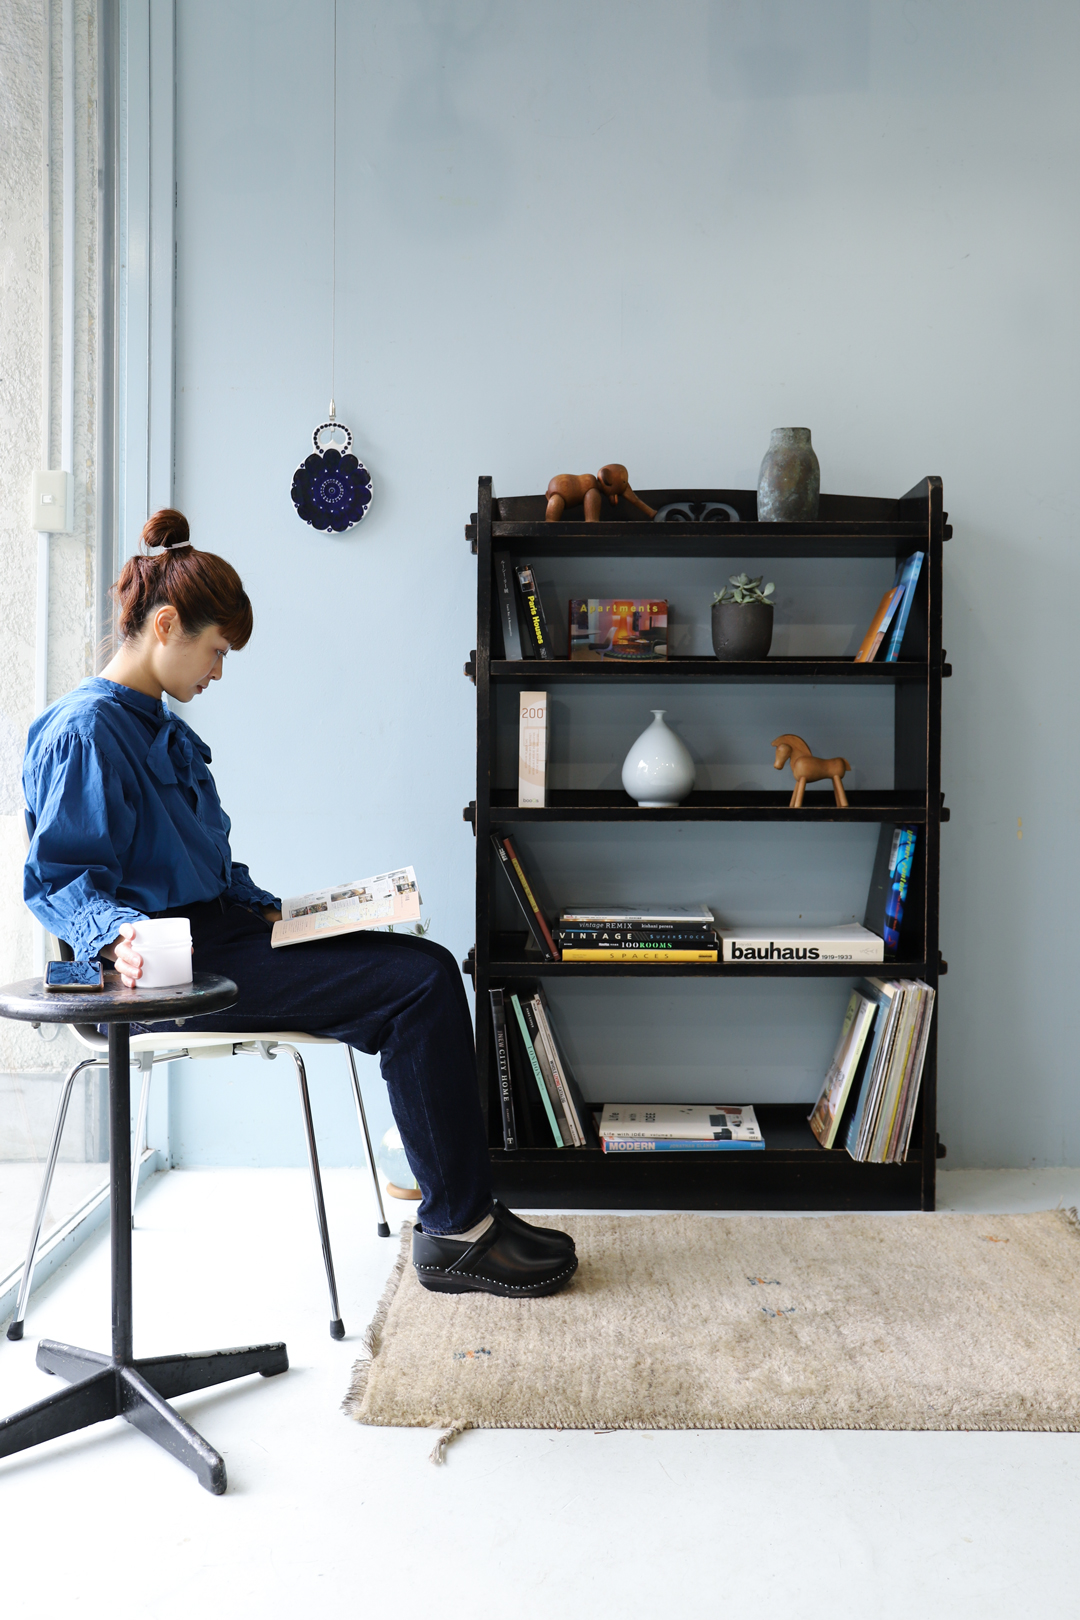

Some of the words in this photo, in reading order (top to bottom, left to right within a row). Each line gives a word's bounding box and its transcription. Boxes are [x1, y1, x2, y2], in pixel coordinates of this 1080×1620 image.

[527, 595, 538, 616] Paris
[580, 604, 659, 614] Apartments
[532, 616, 544, 645] Houses
[521, 707, 544, 719] 200
[559, 932, 633, 940] VINTAGE
[731, 941, 820, 960] bauhaus
[499, 1049, 507, 1071] CITY
[527, 1045, 542, 1077] LONDON
[501, 1075, 510, 1102] HOME
[608, 1141, 656, 1151] MODERN
